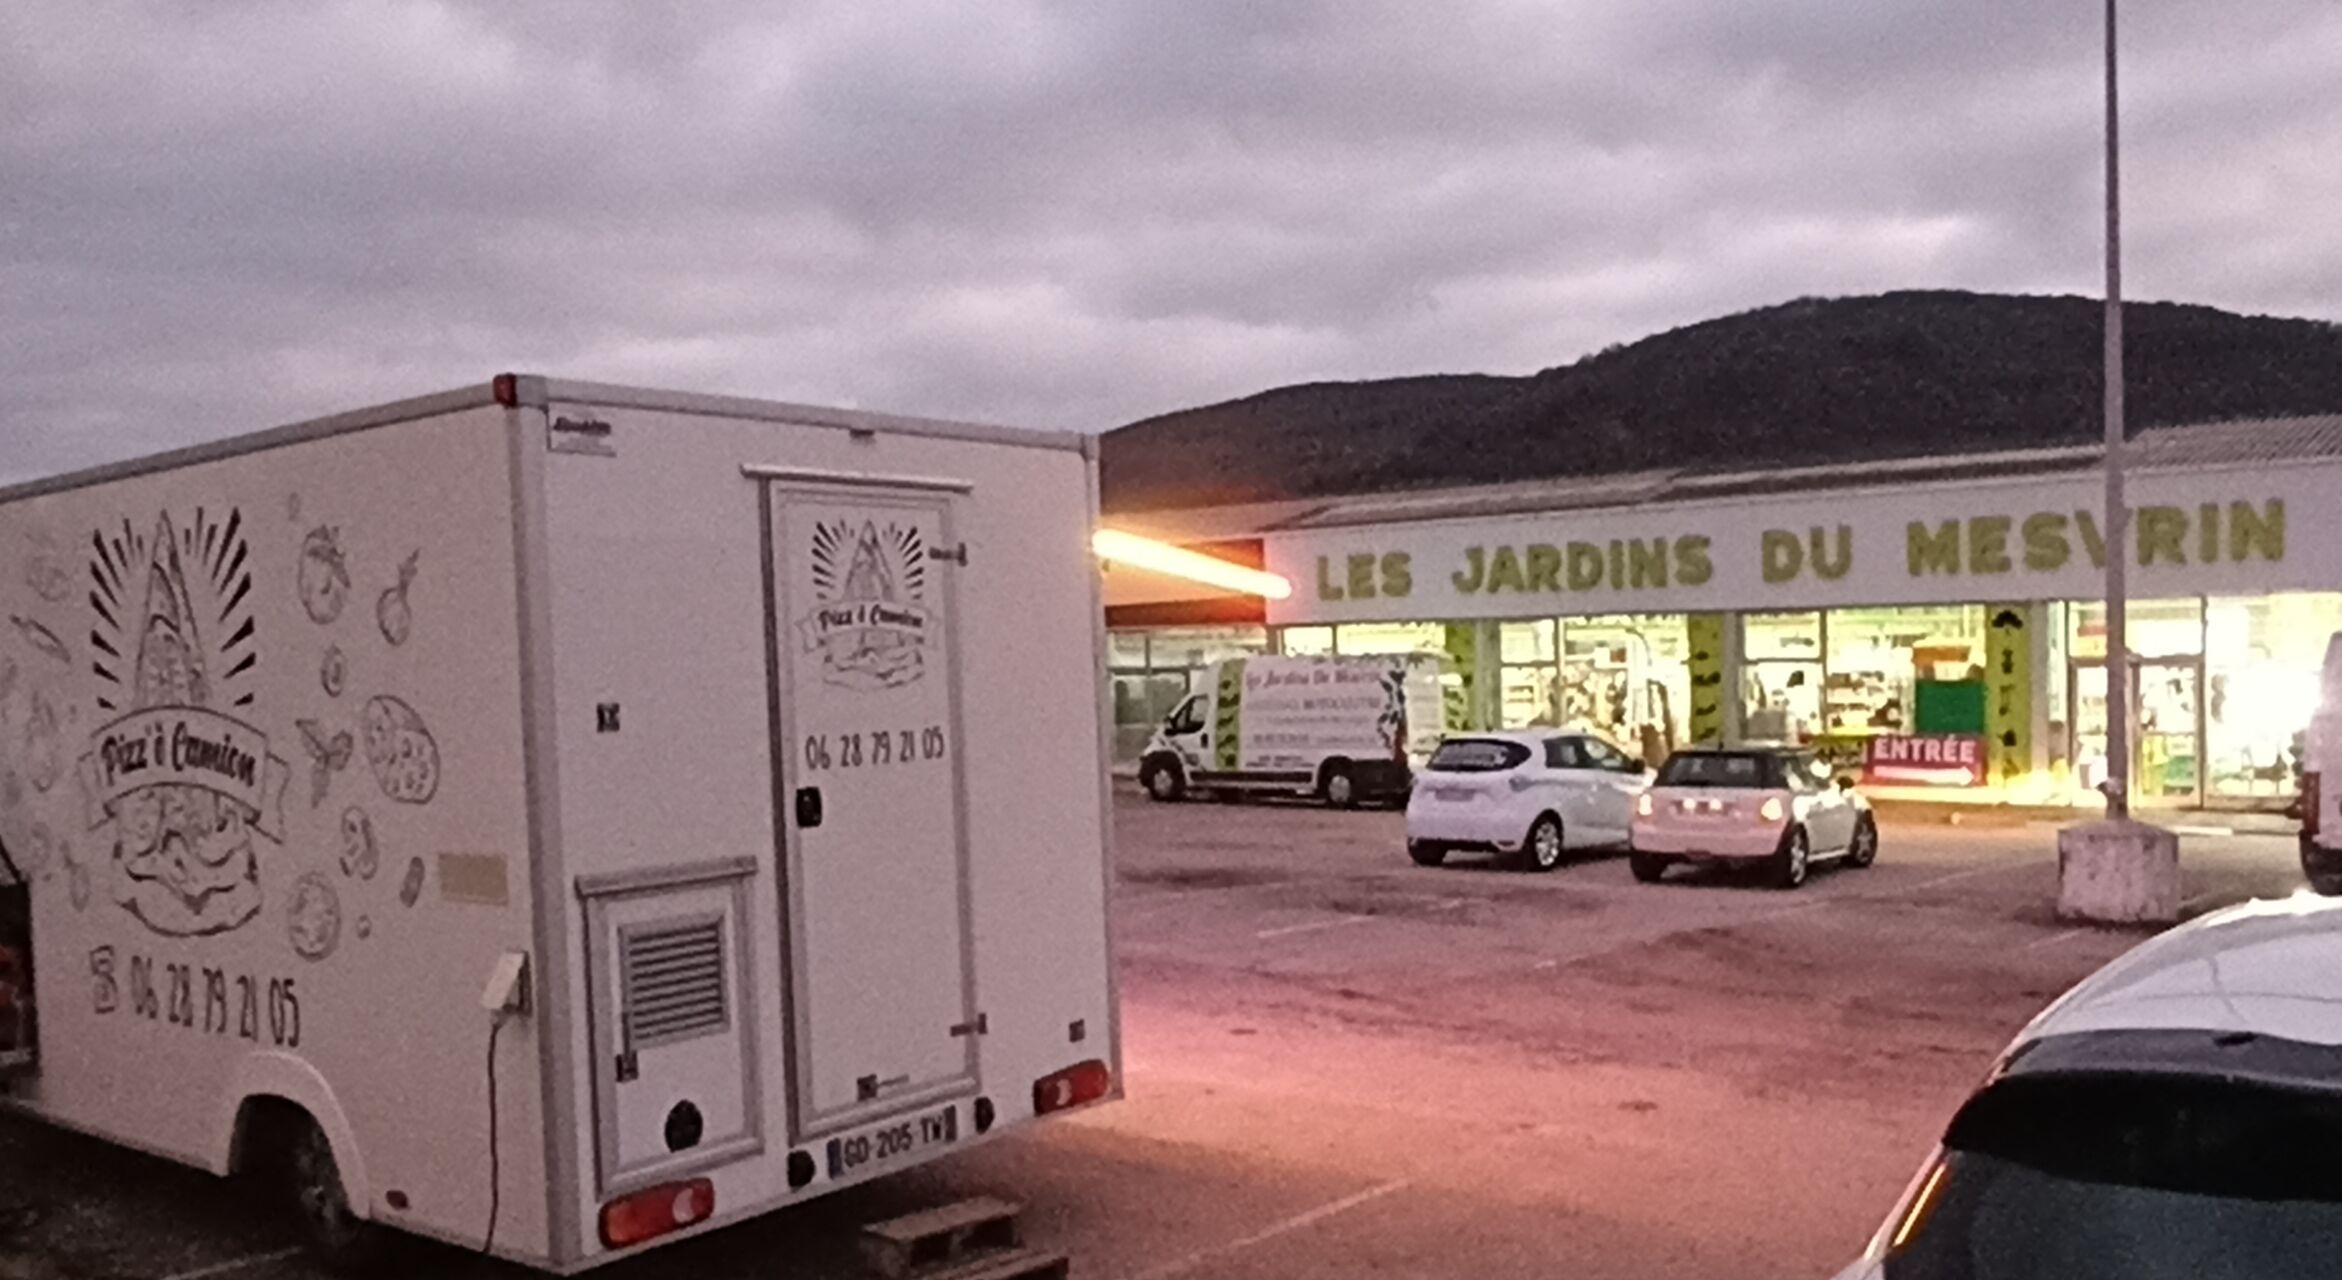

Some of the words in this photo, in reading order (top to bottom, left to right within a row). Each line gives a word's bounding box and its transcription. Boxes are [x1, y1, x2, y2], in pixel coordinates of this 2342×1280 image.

[1316, 552, 1412, 601] LES
[1452, 534, 1713, 594] JARDINS
[1761, 524, 1853, 584] DU
[1906, 499, 2286, 578] MESVRIN
[805, 735, 831, 770] 06
[840, 733, 863, 767] 28
[871, 730, 892, 765] 79
[899, 730, 916, 762] 21
[922, 725, 945, 759] 05
[1873, 733, 1977, 763] ENTRÉE
[131, 955, 158, 1019] 06
[167, 963, 193, 1027] 28
[202, 966, 227, 1034] 79
[236, 974, 258, 1043] 21
[269, 977, 299, 1048] 05
